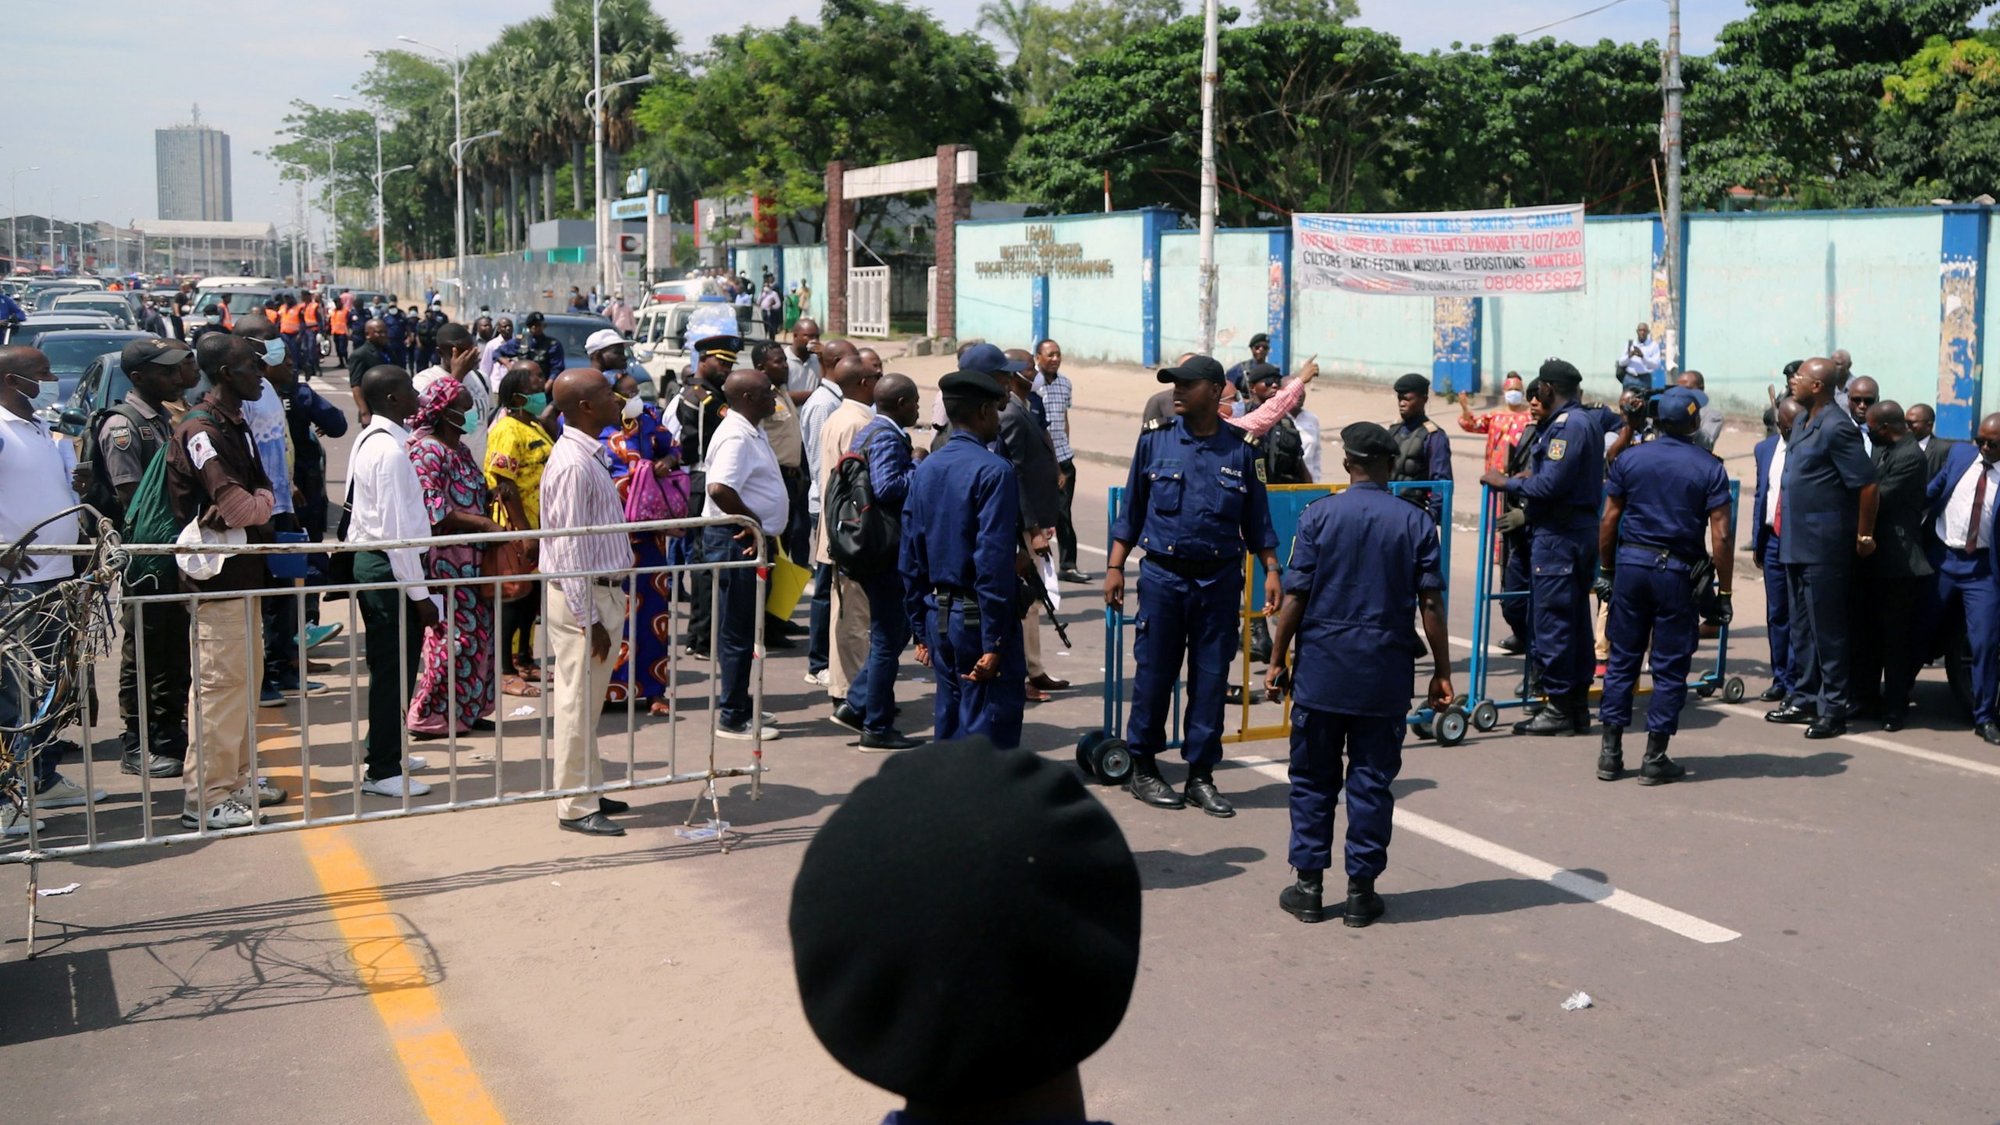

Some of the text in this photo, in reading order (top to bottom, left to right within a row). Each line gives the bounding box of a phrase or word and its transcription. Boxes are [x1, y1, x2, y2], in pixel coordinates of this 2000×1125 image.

[1526, 212, 1574, 229] CANADA
[1391, 237, 1422, 254] JEUNES
[1425, 237, 1465, 254] TALENTS
[1303, 250, 1341, 269] CULTURE
[1413, 257, 1452, 272] MUSICAL
[1463, 256, 1526, 271] EXPOSITIONS
[1534, 251, 1584, 269] MONTREAL
[1220, 466, 1242, 478] POLICE
